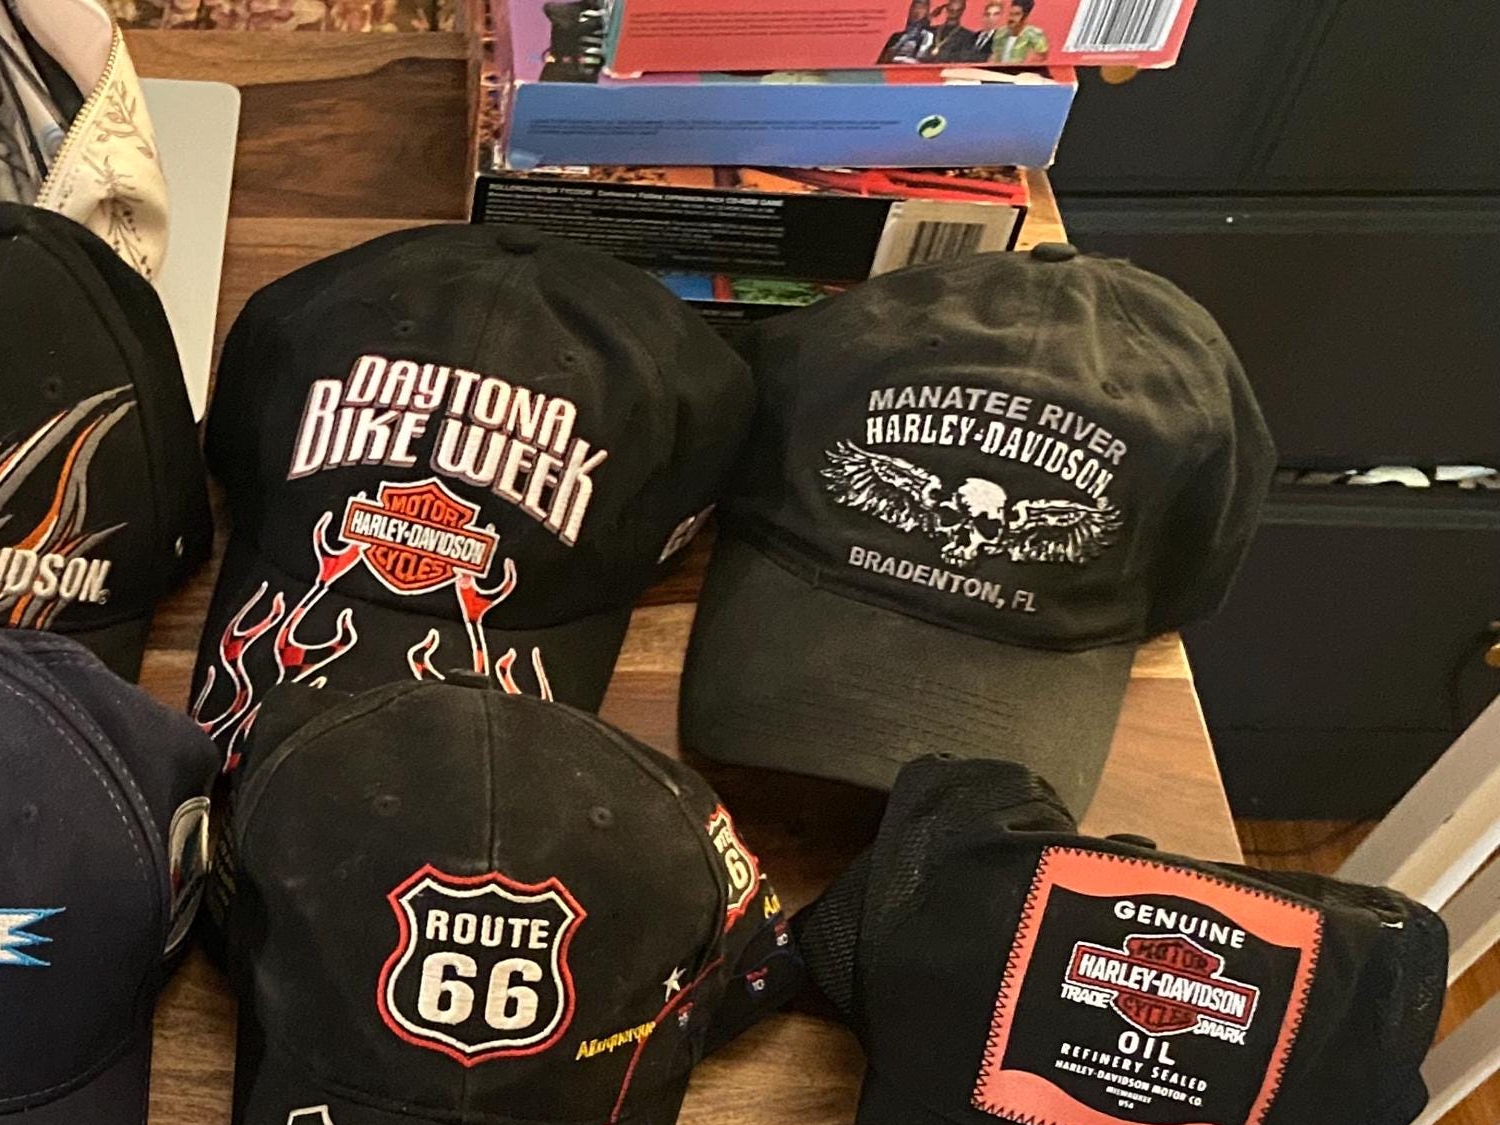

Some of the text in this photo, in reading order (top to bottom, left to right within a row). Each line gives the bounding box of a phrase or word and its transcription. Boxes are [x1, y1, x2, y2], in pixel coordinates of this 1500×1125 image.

[343, 355, 578, 453] DAYTONA
[868, 386, 1127, 466] MANATEE RIVER
[286, 379, 608, 547] BIKE WEEK
[866, 413, 1113, 499] HARLEY-DAVIDSON
[391, 493, 459, 528] MOTOR
[350, 510, 488, 565] HARLEY-DAVIDSON
[376, 546, 445, 581] CYCLES
[848, 545, 1037, 613] BRADENTON, FL
[425, 909, 551, 951] ROUTE
[1113, 899, 1247, 950] GENUINE
[417, 951, 544, 1031] 66
[1060, 983, 1113, 1009] TRADE
[1077, 953, 1249, 1019] HARLEY-DAVIDSON
[1117, 1030, 1176, 1066] OIL
[1199, 1019, 1247, 1046] MARK
[1054, 1059, 1151, 1092] HARLEY-DAVIDSON
[1151, 1084, 1188, 1102] MOTOR
[1060, 1042, 1208, 1092] REFINERY SEALED
[1117, 1099, 1135, 1110] USA
